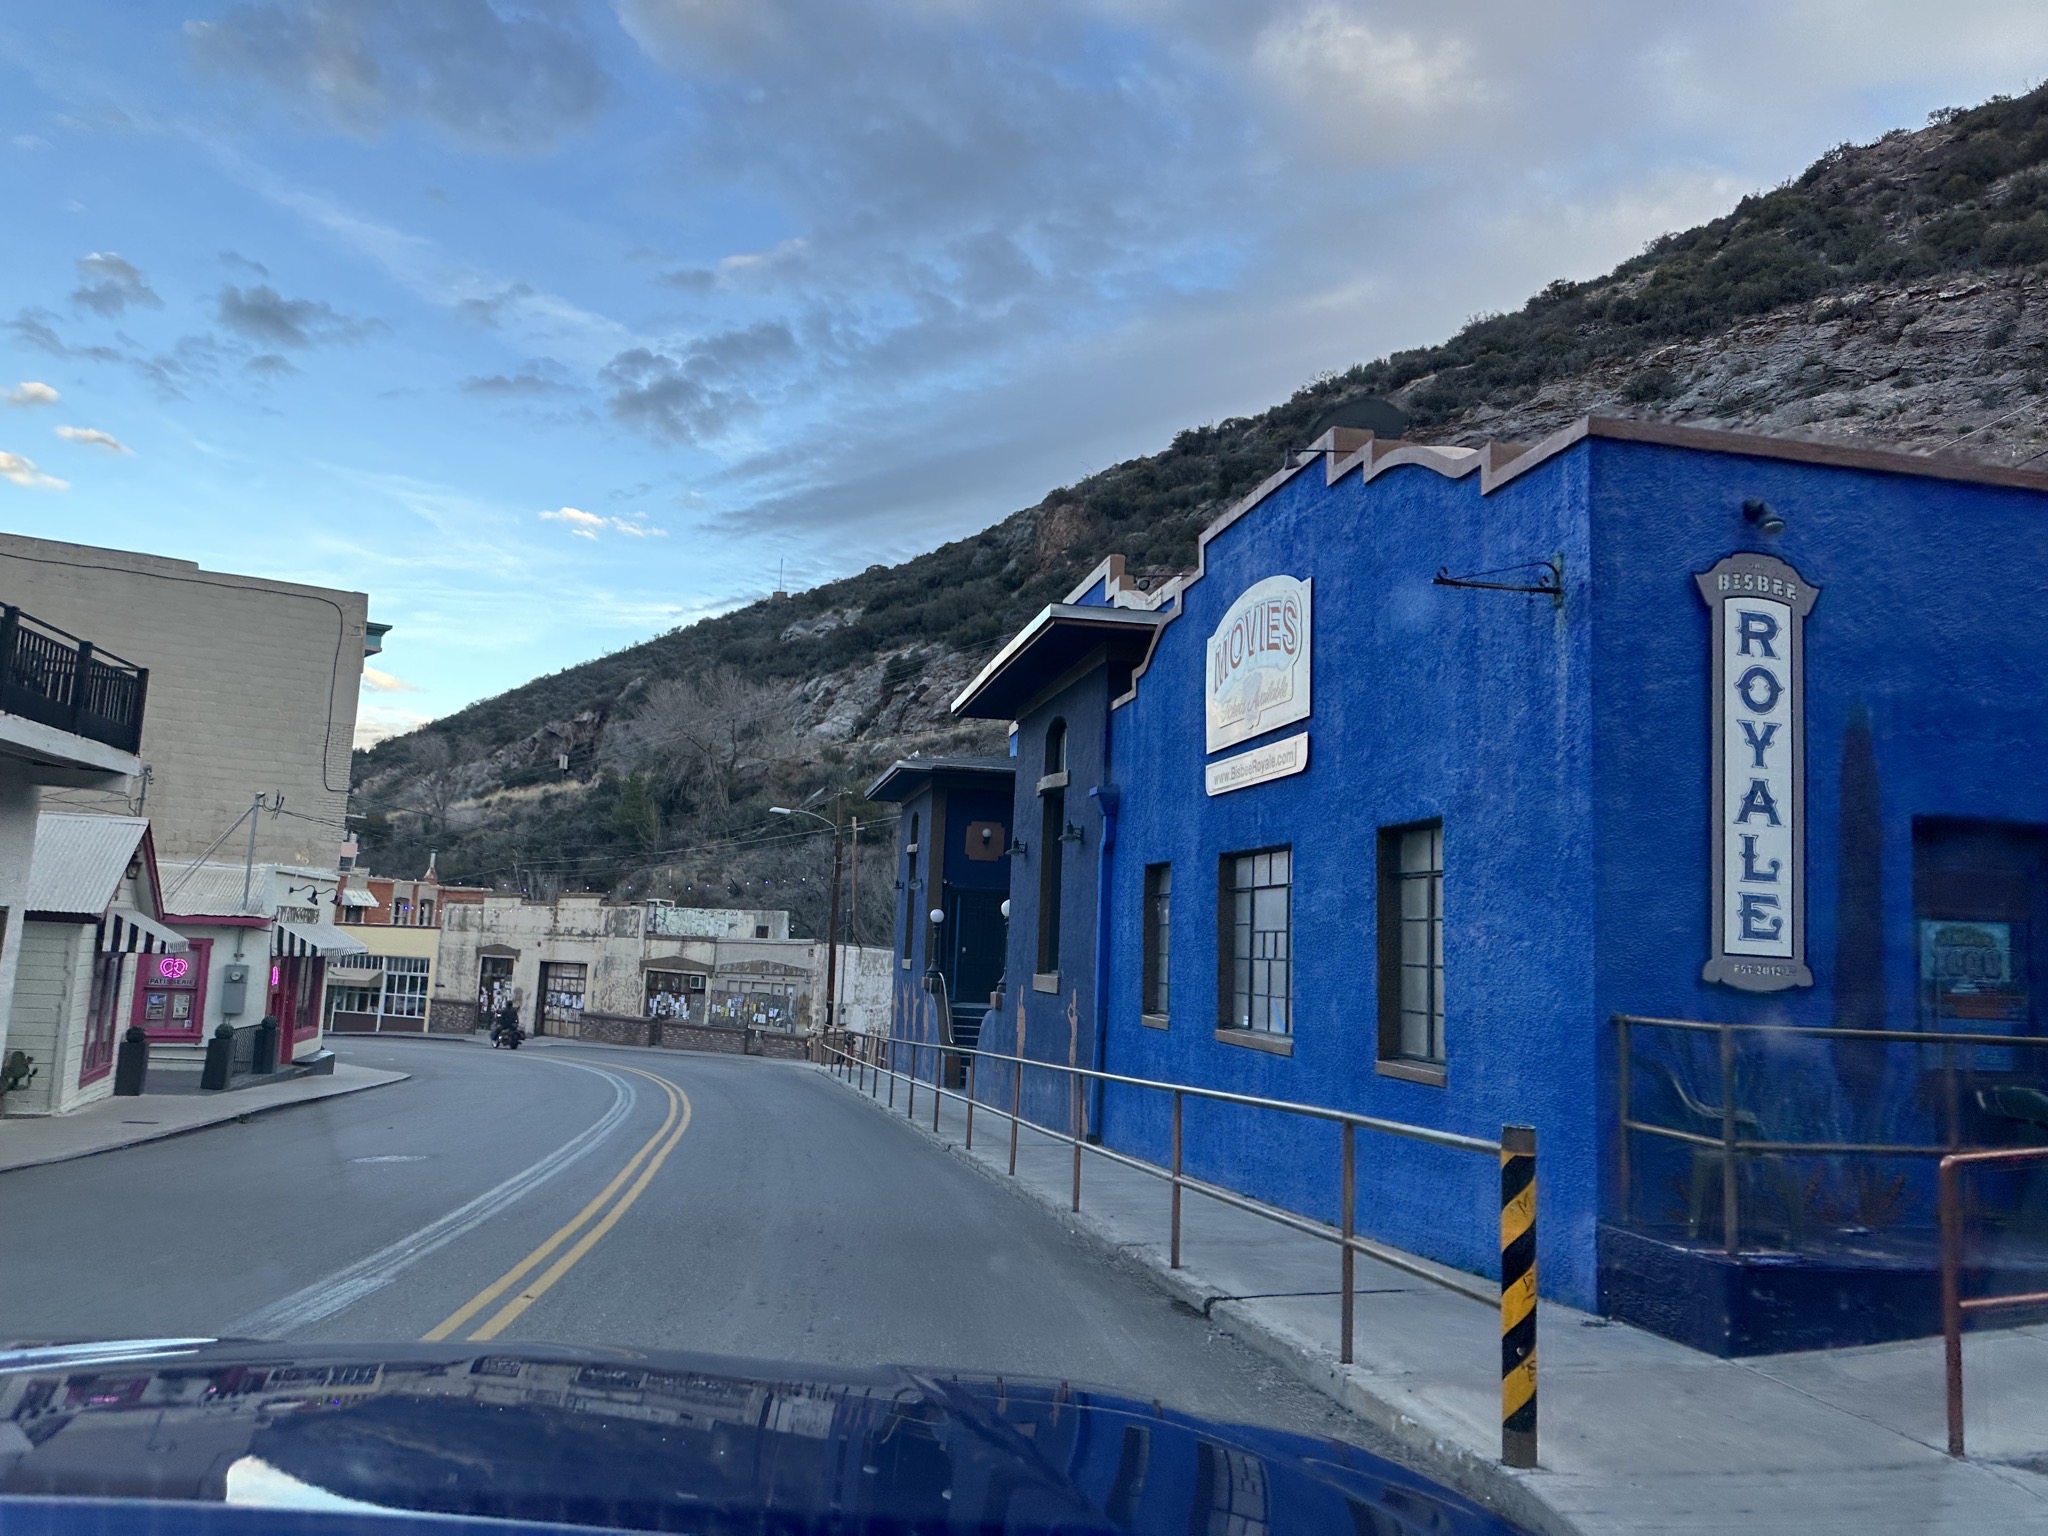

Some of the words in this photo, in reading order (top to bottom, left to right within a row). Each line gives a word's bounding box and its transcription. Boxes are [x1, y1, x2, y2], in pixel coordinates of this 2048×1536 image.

[1718, 573, 1797, 600] BISBEE
[1213, 599, 1298, 695] MOVIES
[1213, 750, 1294, 786] www.BisbeeRoyale.com
[1733, 609, 1786, 943] ROYALE
